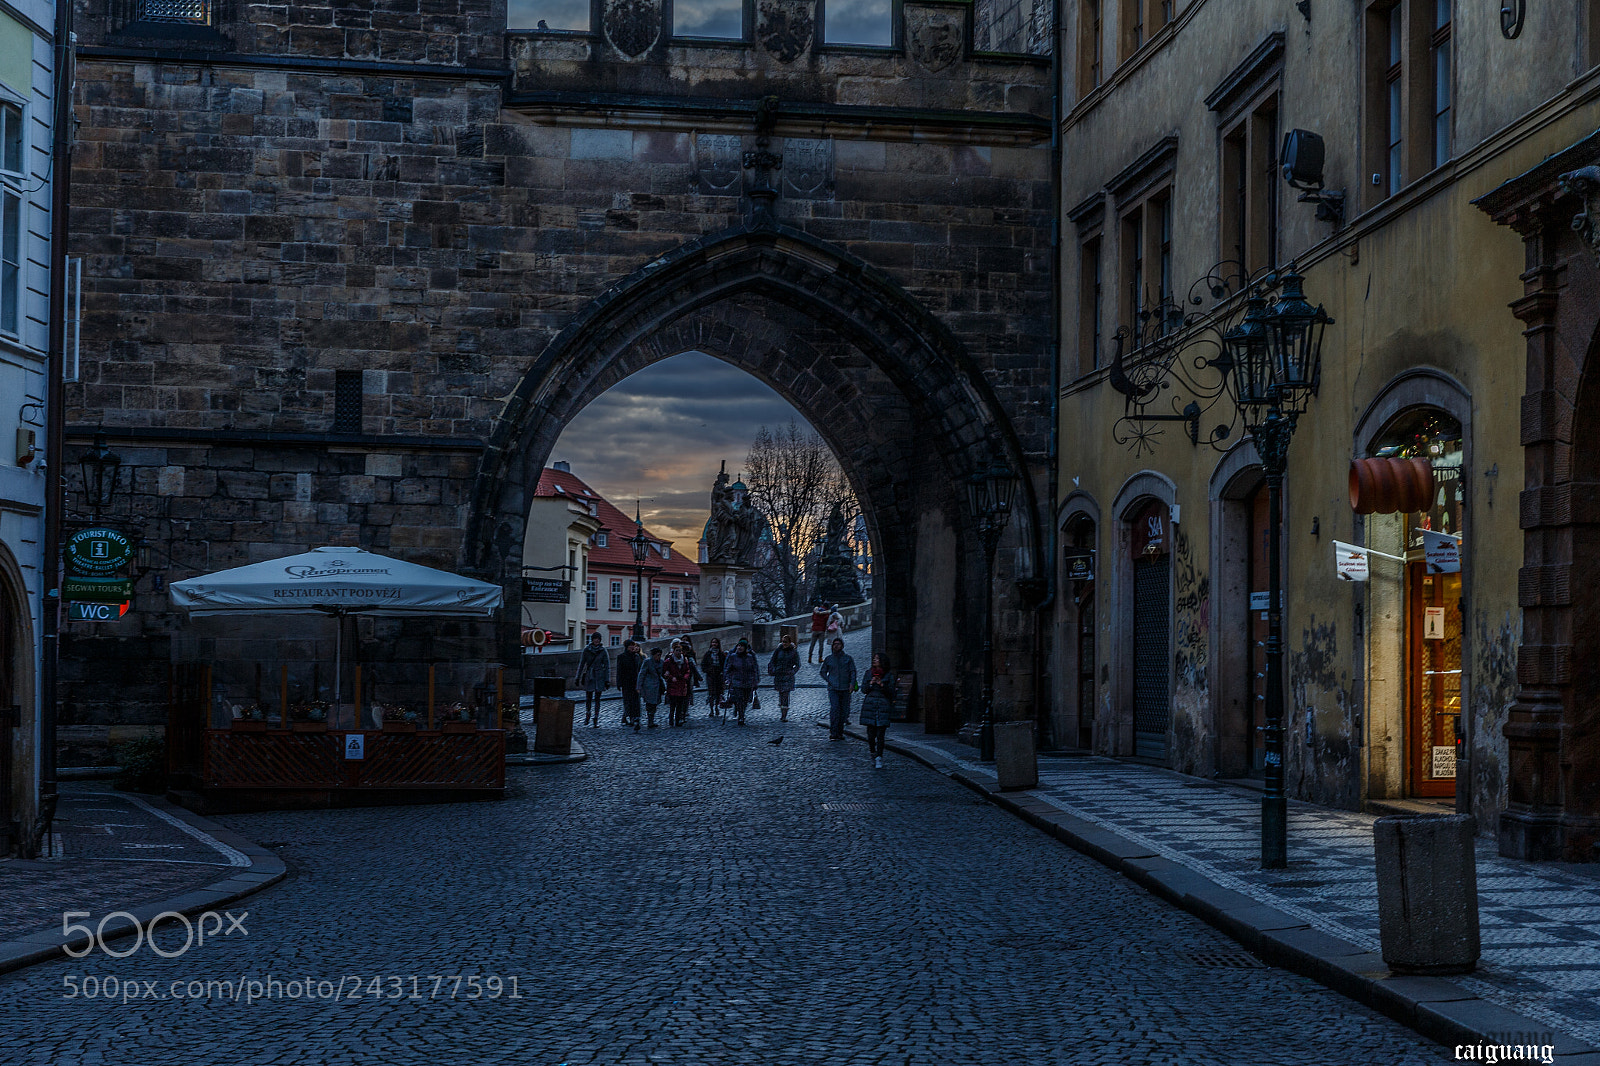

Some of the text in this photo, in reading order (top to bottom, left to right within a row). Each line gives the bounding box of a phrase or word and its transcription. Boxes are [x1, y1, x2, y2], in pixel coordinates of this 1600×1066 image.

[72, 530, 127, 546] TOURIST INFO
[285, 565, 392, 580] Staropramen
[66, 584, 122, 593] SEGWAY TOURS
[274, 587, 402, 599] RESTAURANT POD VĚŽÍ
[80, 604, 110, 620] WC
